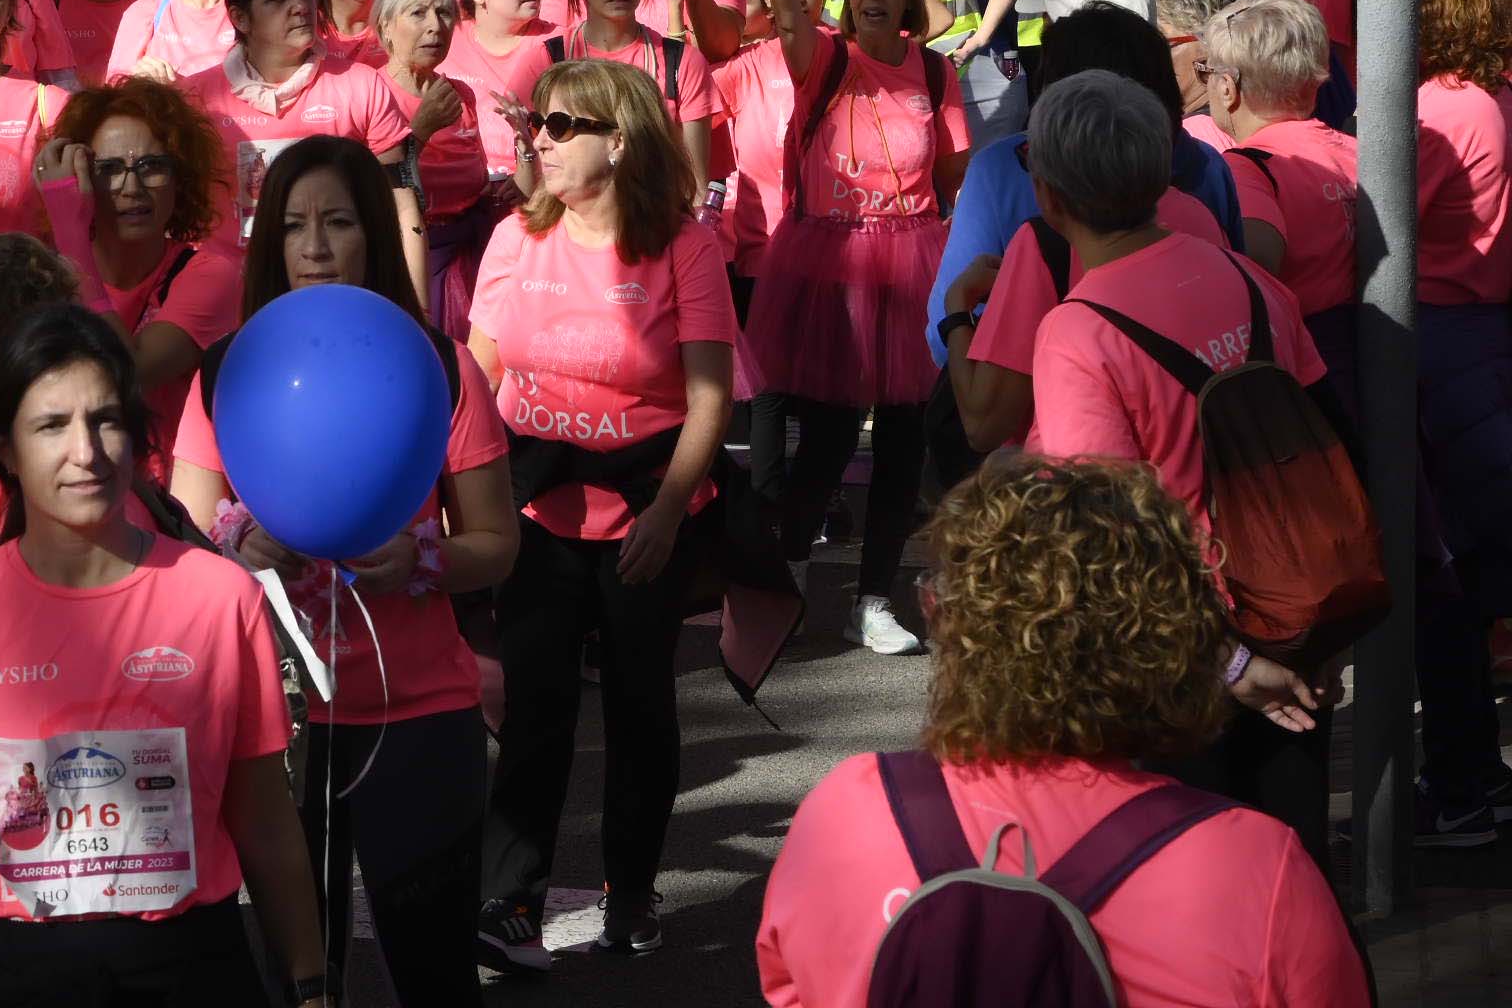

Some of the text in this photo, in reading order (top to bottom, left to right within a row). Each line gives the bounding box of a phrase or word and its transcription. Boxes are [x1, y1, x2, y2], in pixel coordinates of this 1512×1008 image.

[222, 117, 268, 127] OYSHO
[836, 152, 865, 179] TU
[515, 403, 635, 441] DORSAL
[128, 661, 189, 676] ASTURIANA
[132, 755, 173, 766] SUMA
[54, 767, 120, 781] ASTURIANA
[56, 802, 121, 831] 016
[13, 857, 174, 879] CARRERA DE LA MUJER 2023
[118, 883, 180, 897] Santander
